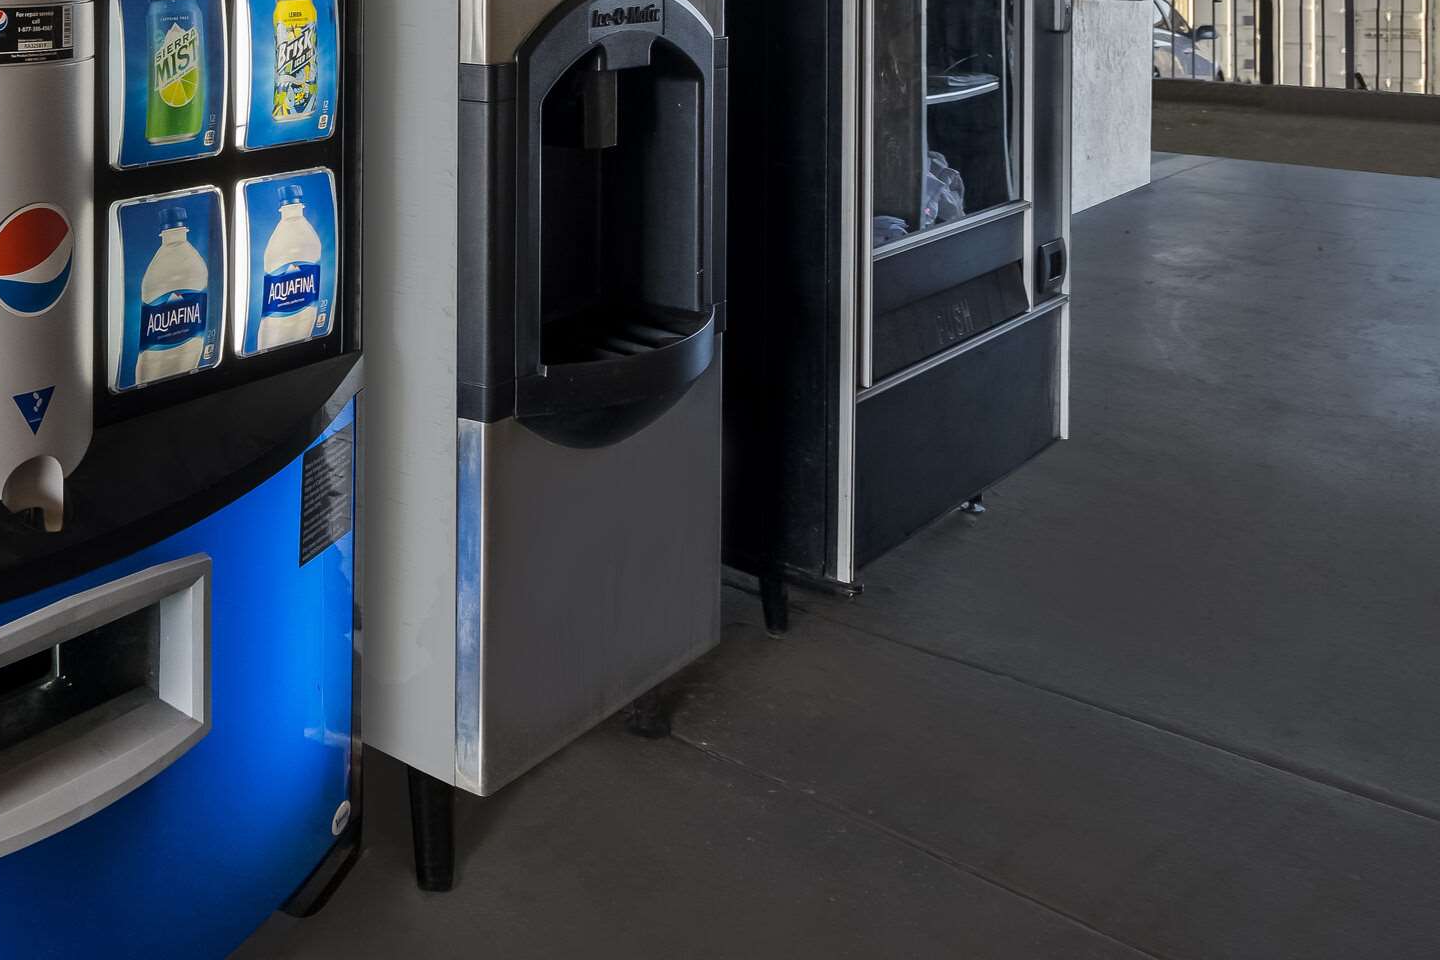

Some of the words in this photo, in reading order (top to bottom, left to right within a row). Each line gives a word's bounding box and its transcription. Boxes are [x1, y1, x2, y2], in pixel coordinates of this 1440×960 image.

[592, 3, 660, 28] Ice-O-Matic
[156, 38, 197, 81] MIST
[268, 273, 315, 304] AQUAFINA
[146, 302, 201, 337] AQUAFINA
